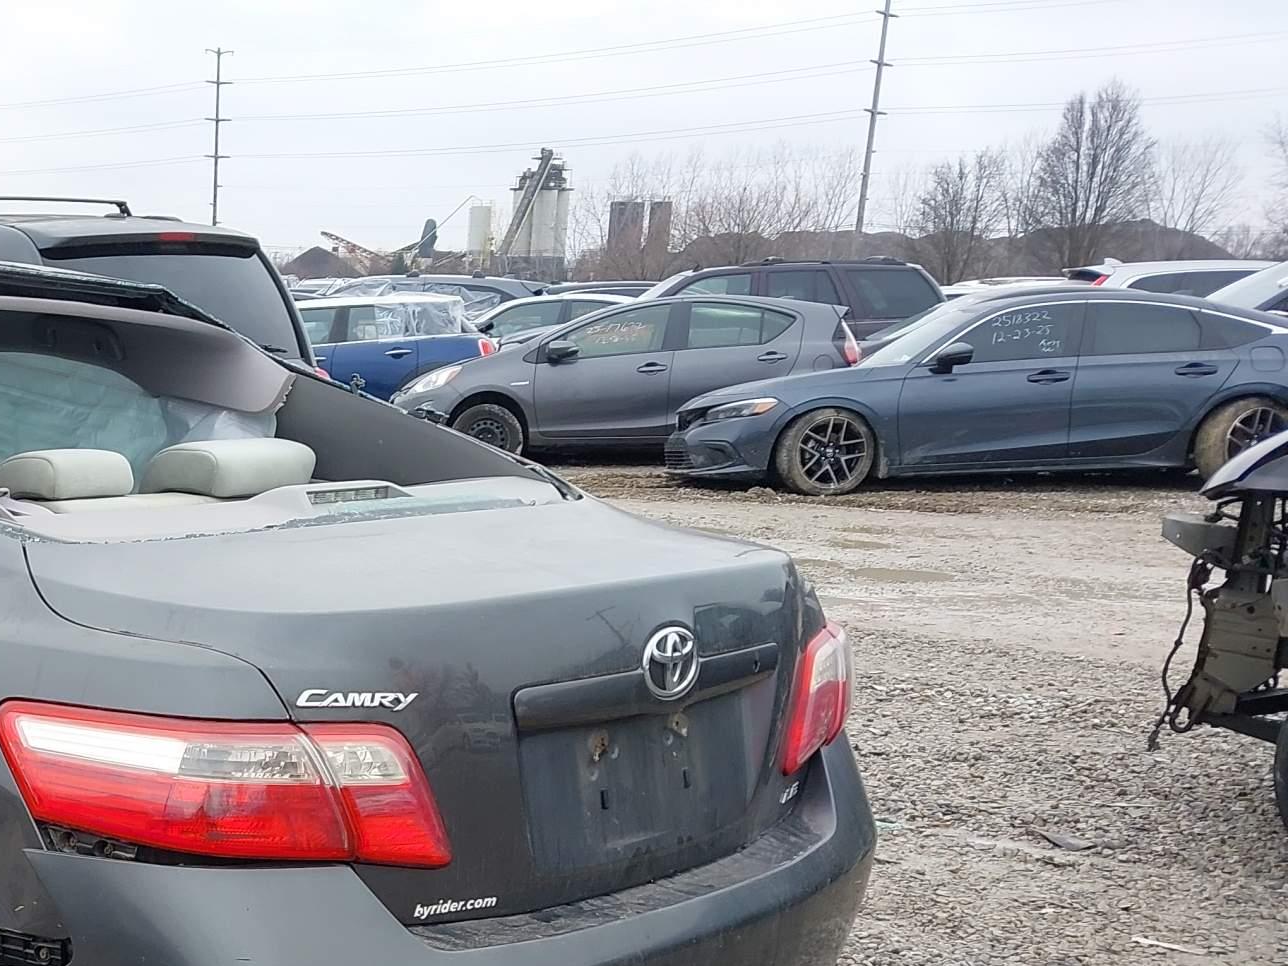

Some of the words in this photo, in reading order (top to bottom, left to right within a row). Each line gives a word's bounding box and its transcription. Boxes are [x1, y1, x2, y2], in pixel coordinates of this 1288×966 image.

[991, 310, 1052, 327] 2518322
[991, 324, 1054, 345] 12-23-25
[413, 897, 498, 920] byrider.com
